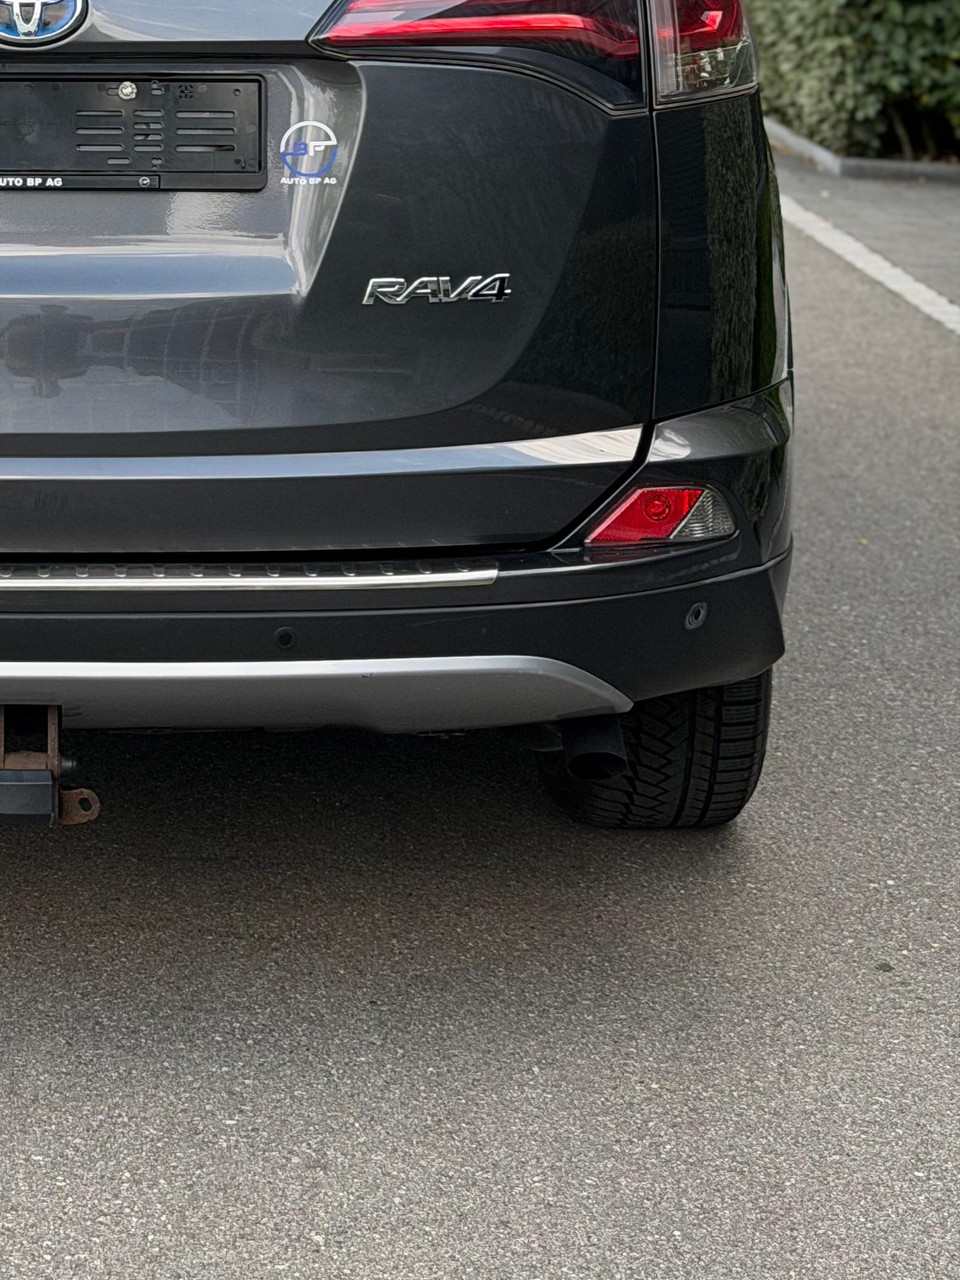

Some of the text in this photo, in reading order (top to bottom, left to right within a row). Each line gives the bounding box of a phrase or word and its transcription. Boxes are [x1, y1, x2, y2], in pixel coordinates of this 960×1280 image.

[26, 177, 43, 187] BP
[45, 177, 63, 187] AG
[280, 177, 337, 185] AUTO BP AG
[362, 273, 512, 304] RAV4
